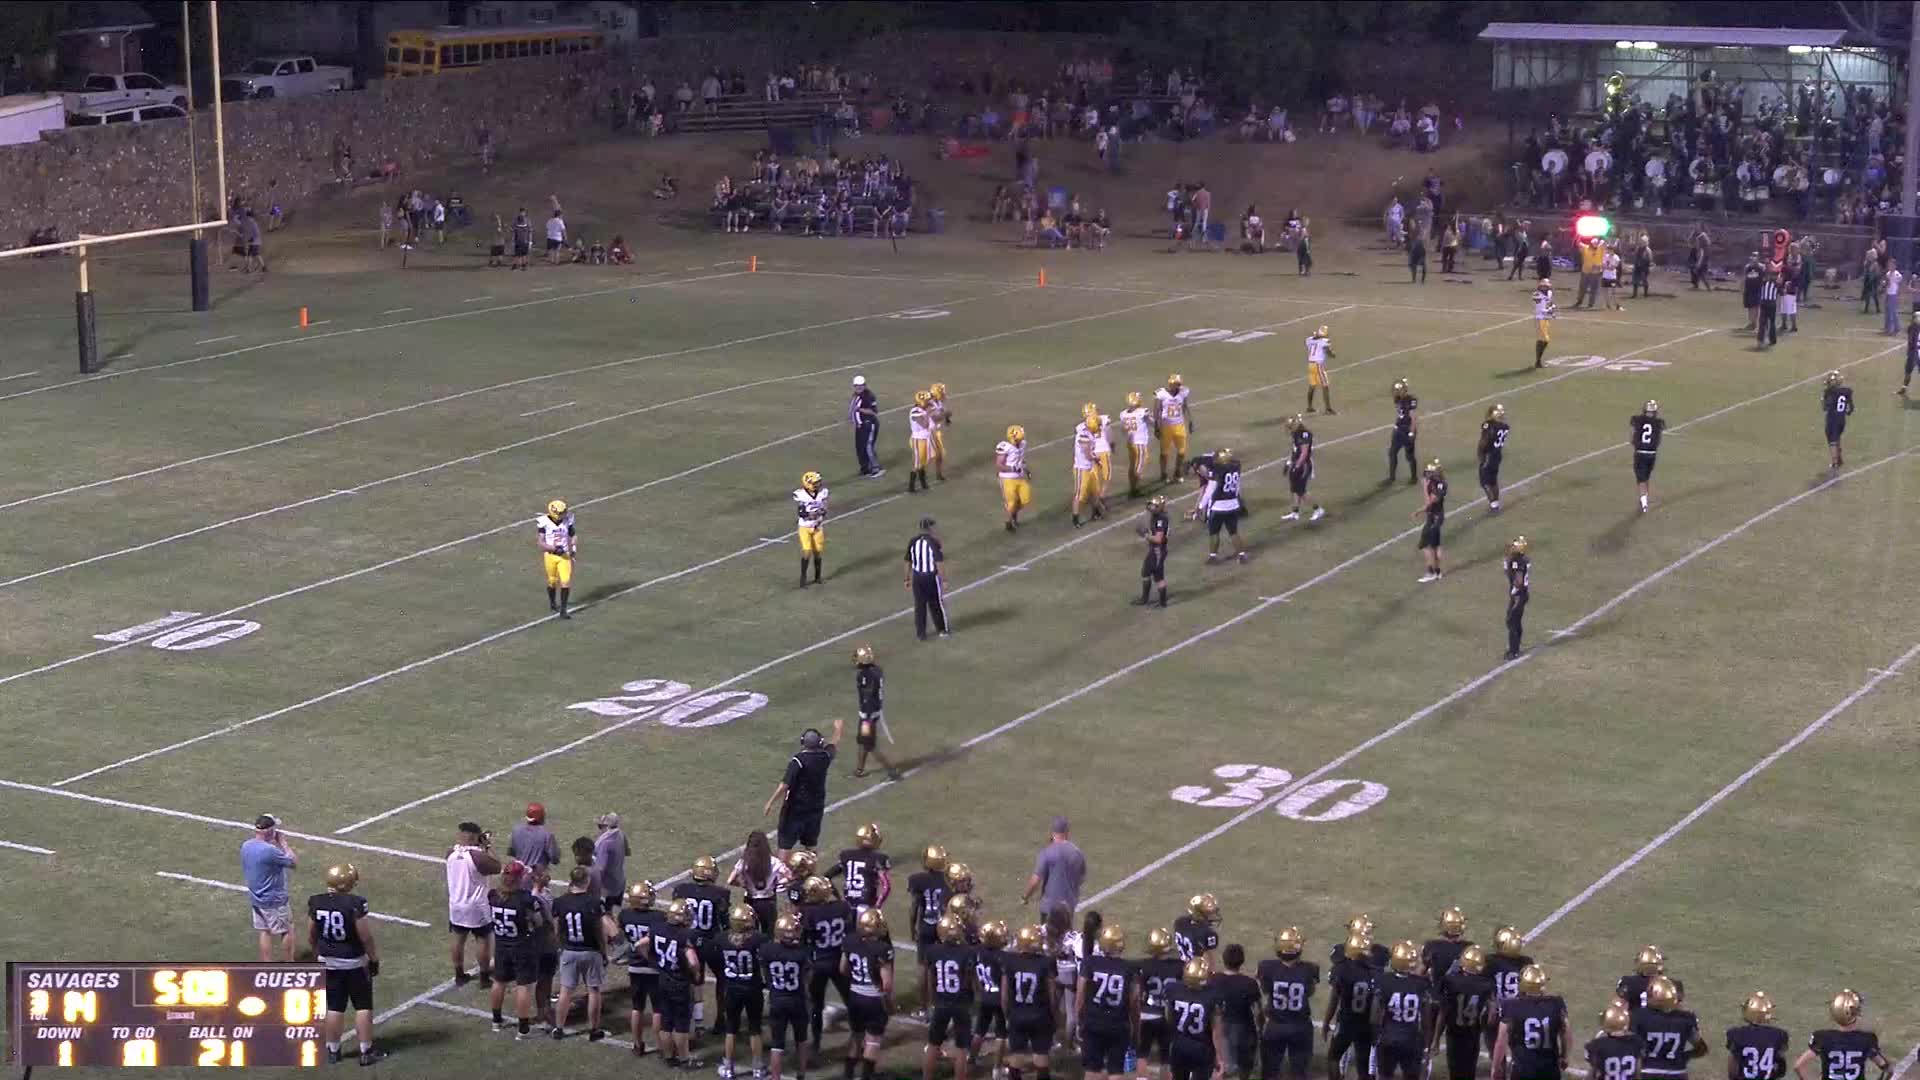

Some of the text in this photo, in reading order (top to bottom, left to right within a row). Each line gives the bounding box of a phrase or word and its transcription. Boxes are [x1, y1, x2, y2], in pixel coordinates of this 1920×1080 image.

[1836, 395, 1846, 412] 6
[1641, 423, 1652, 443] 2
[93, 611, 261, 650] 10
[565, 679, 769, 728] 20
[1170, 764, 1389, 821] 30
[845, 860, 866, 890] 15
[316, 910, 346, 941] 78
[491, 907, 518, 937] 55
[565, 912, 584, 942] 11
[816, 918, 844, 948] 32
[655, 935, 678, 970] 54
[723, 950, 752, 978] 50
[935, 960, 960, 993] 16
[1015, 971, 1037, 1003] 17
[1093, 971, 1124, 1006] 79
[1272, 981, 1305, 1012] 58
[1175, 1000, 1204, 1034] 73
[1524, 1017, 1550, 1049] 61
[1647, 1032, 1680, 1059] 77
[1742, 1047, 1774, 1080] 34
[1828, 1051, 1863, 1080] 25
